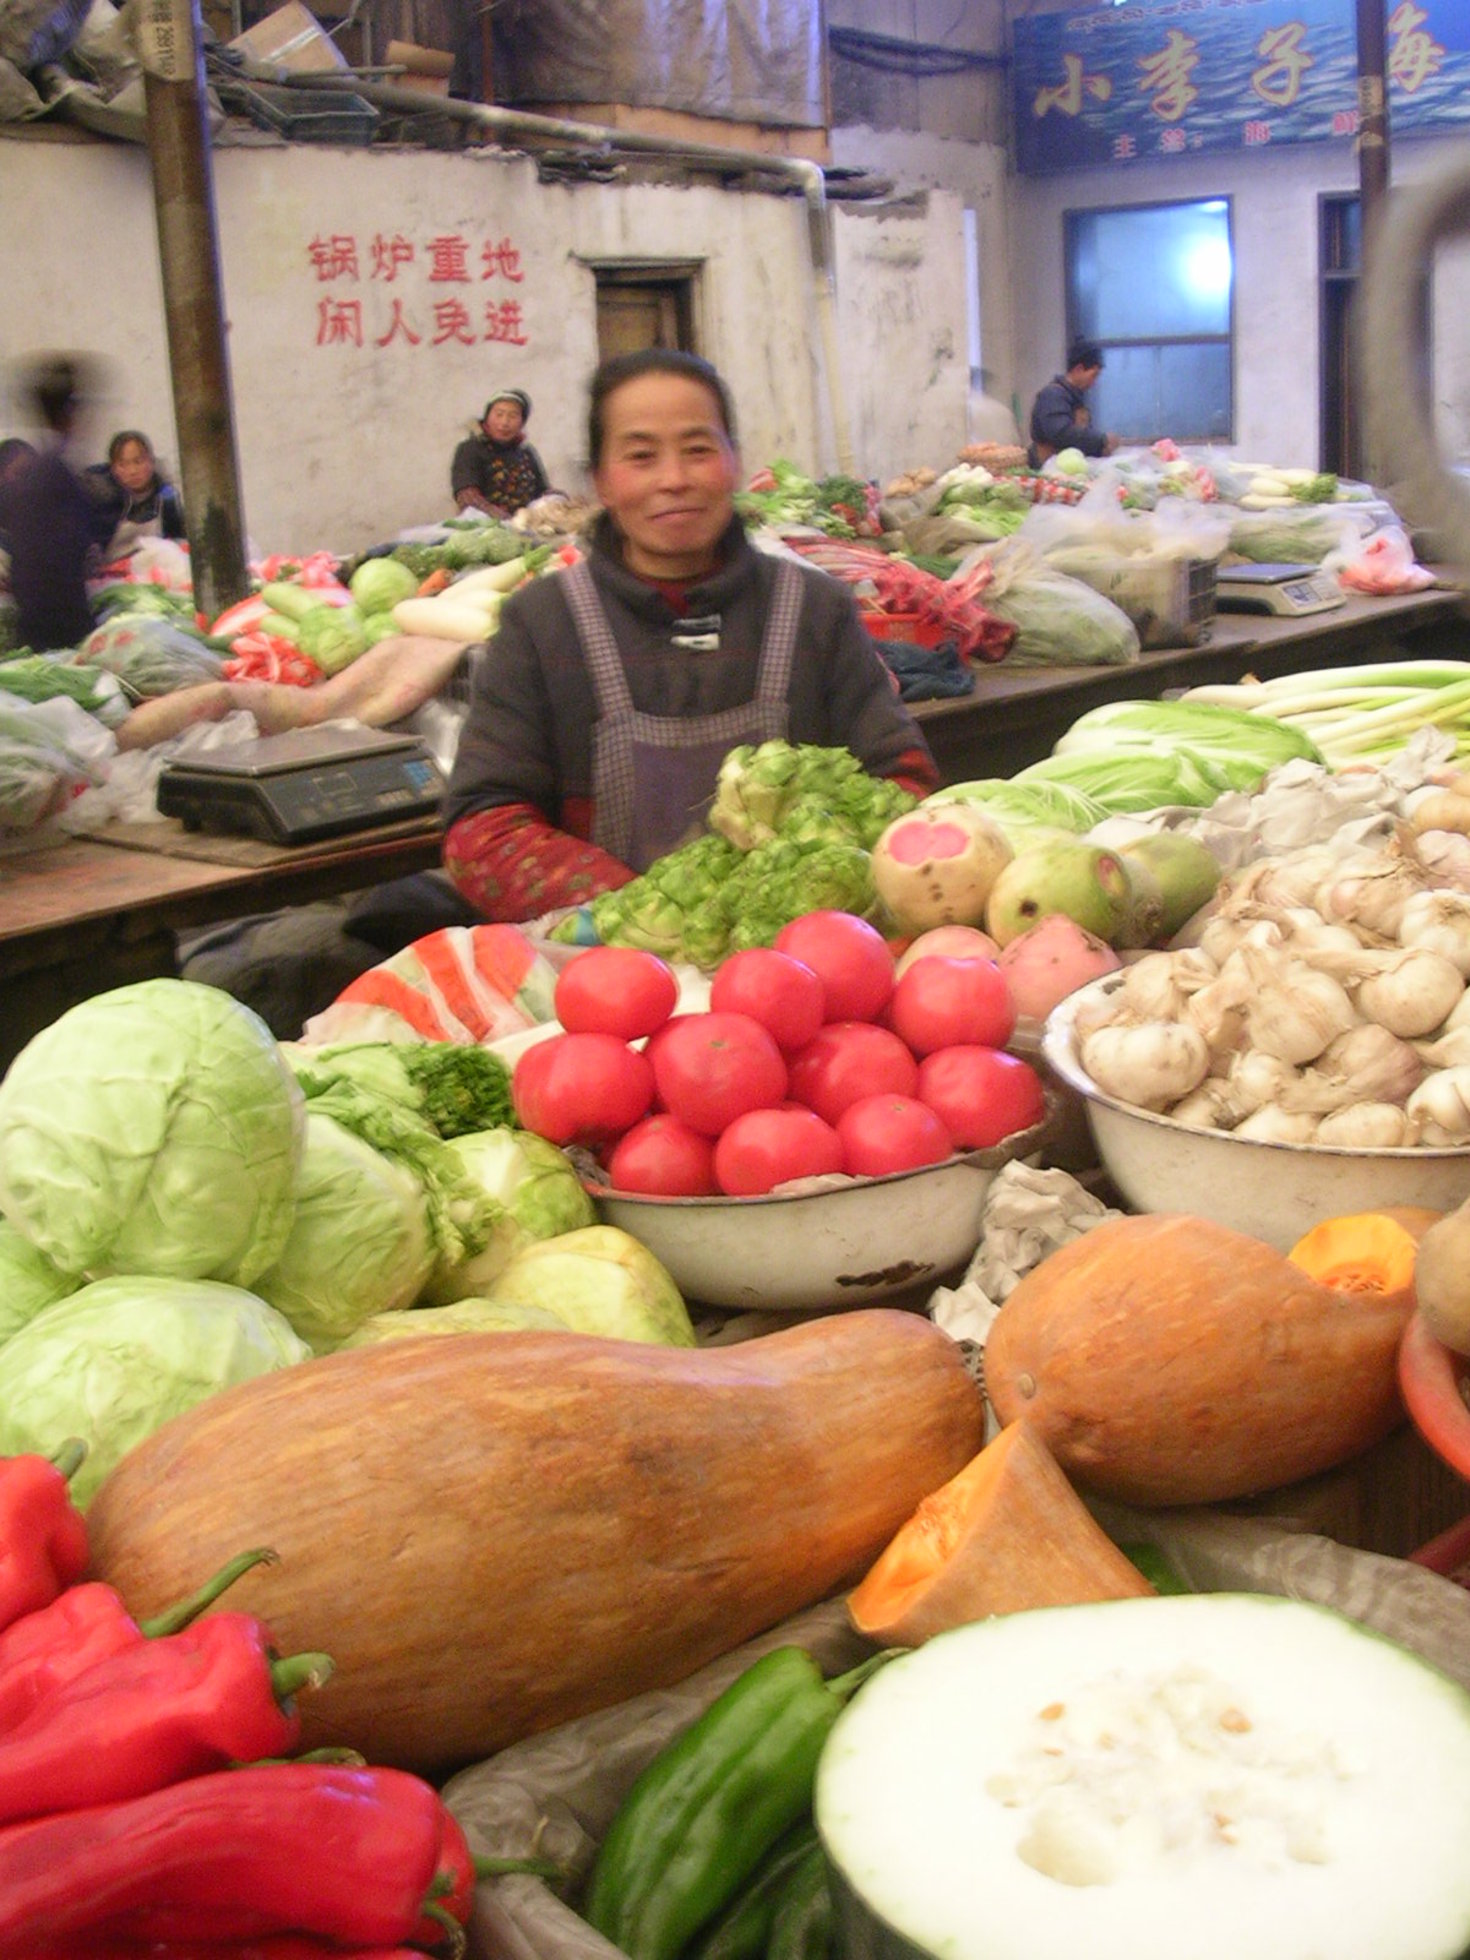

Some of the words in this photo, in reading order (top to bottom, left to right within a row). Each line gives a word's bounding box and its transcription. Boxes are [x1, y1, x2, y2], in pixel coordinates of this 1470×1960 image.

[308, 233, 524, 283] 锅炉重地
[316, 296, 528, 348] 闲人免进
